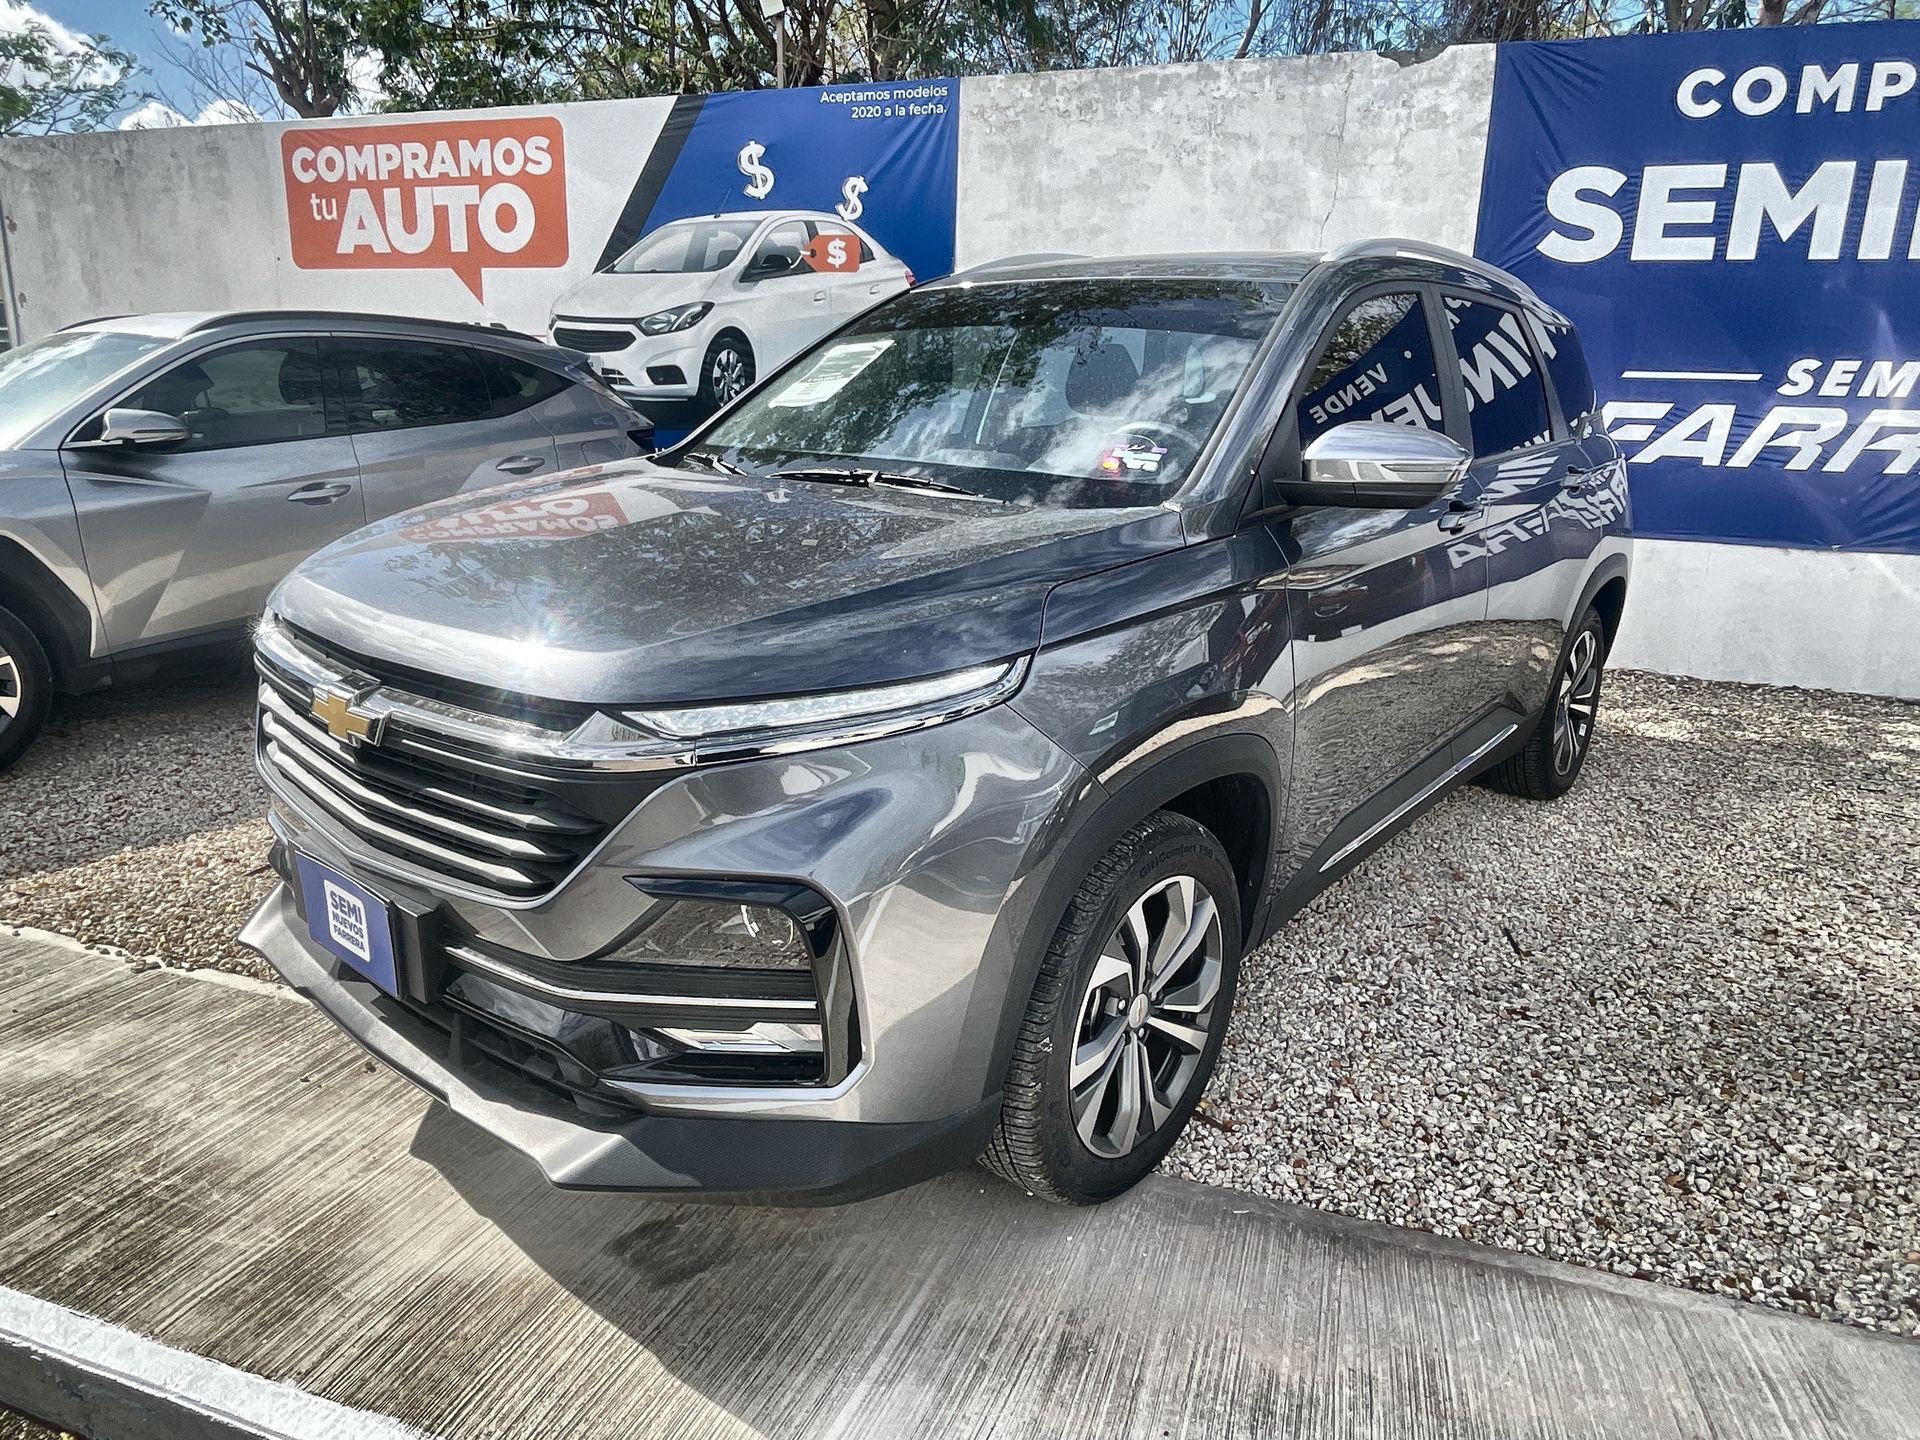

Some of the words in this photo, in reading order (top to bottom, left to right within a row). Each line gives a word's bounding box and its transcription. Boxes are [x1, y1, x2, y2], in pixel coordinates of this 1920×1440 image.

[820, 91, 890, 104] Aceptamos
[894, 84, 948, 100] modelos
[851, 106, 881, 119] 2020
[884, 107, 892, 117] a
[895, 104, 906, 117] la
[909, 102, 947, 116] fecha.
[1676, 60, 1918, 118] COMP
[291, 135, 553, 183] COMPRAMOS
[738, 140, 775, 199] $
[310, 192, 338, 221] tu
[336, 182, 536, 255] AUTO
[835, 175, 869, 220] $
[1535, 160, 1920, 263] SEMI
[827, 238, 847, 268] $
[1776, 357, 1920, 398] SEM
[1601, 400, 1920, 475] FARR
[329, 890, 363, 926] SEMI
[331, 910, 364, 939] NUEVOS
